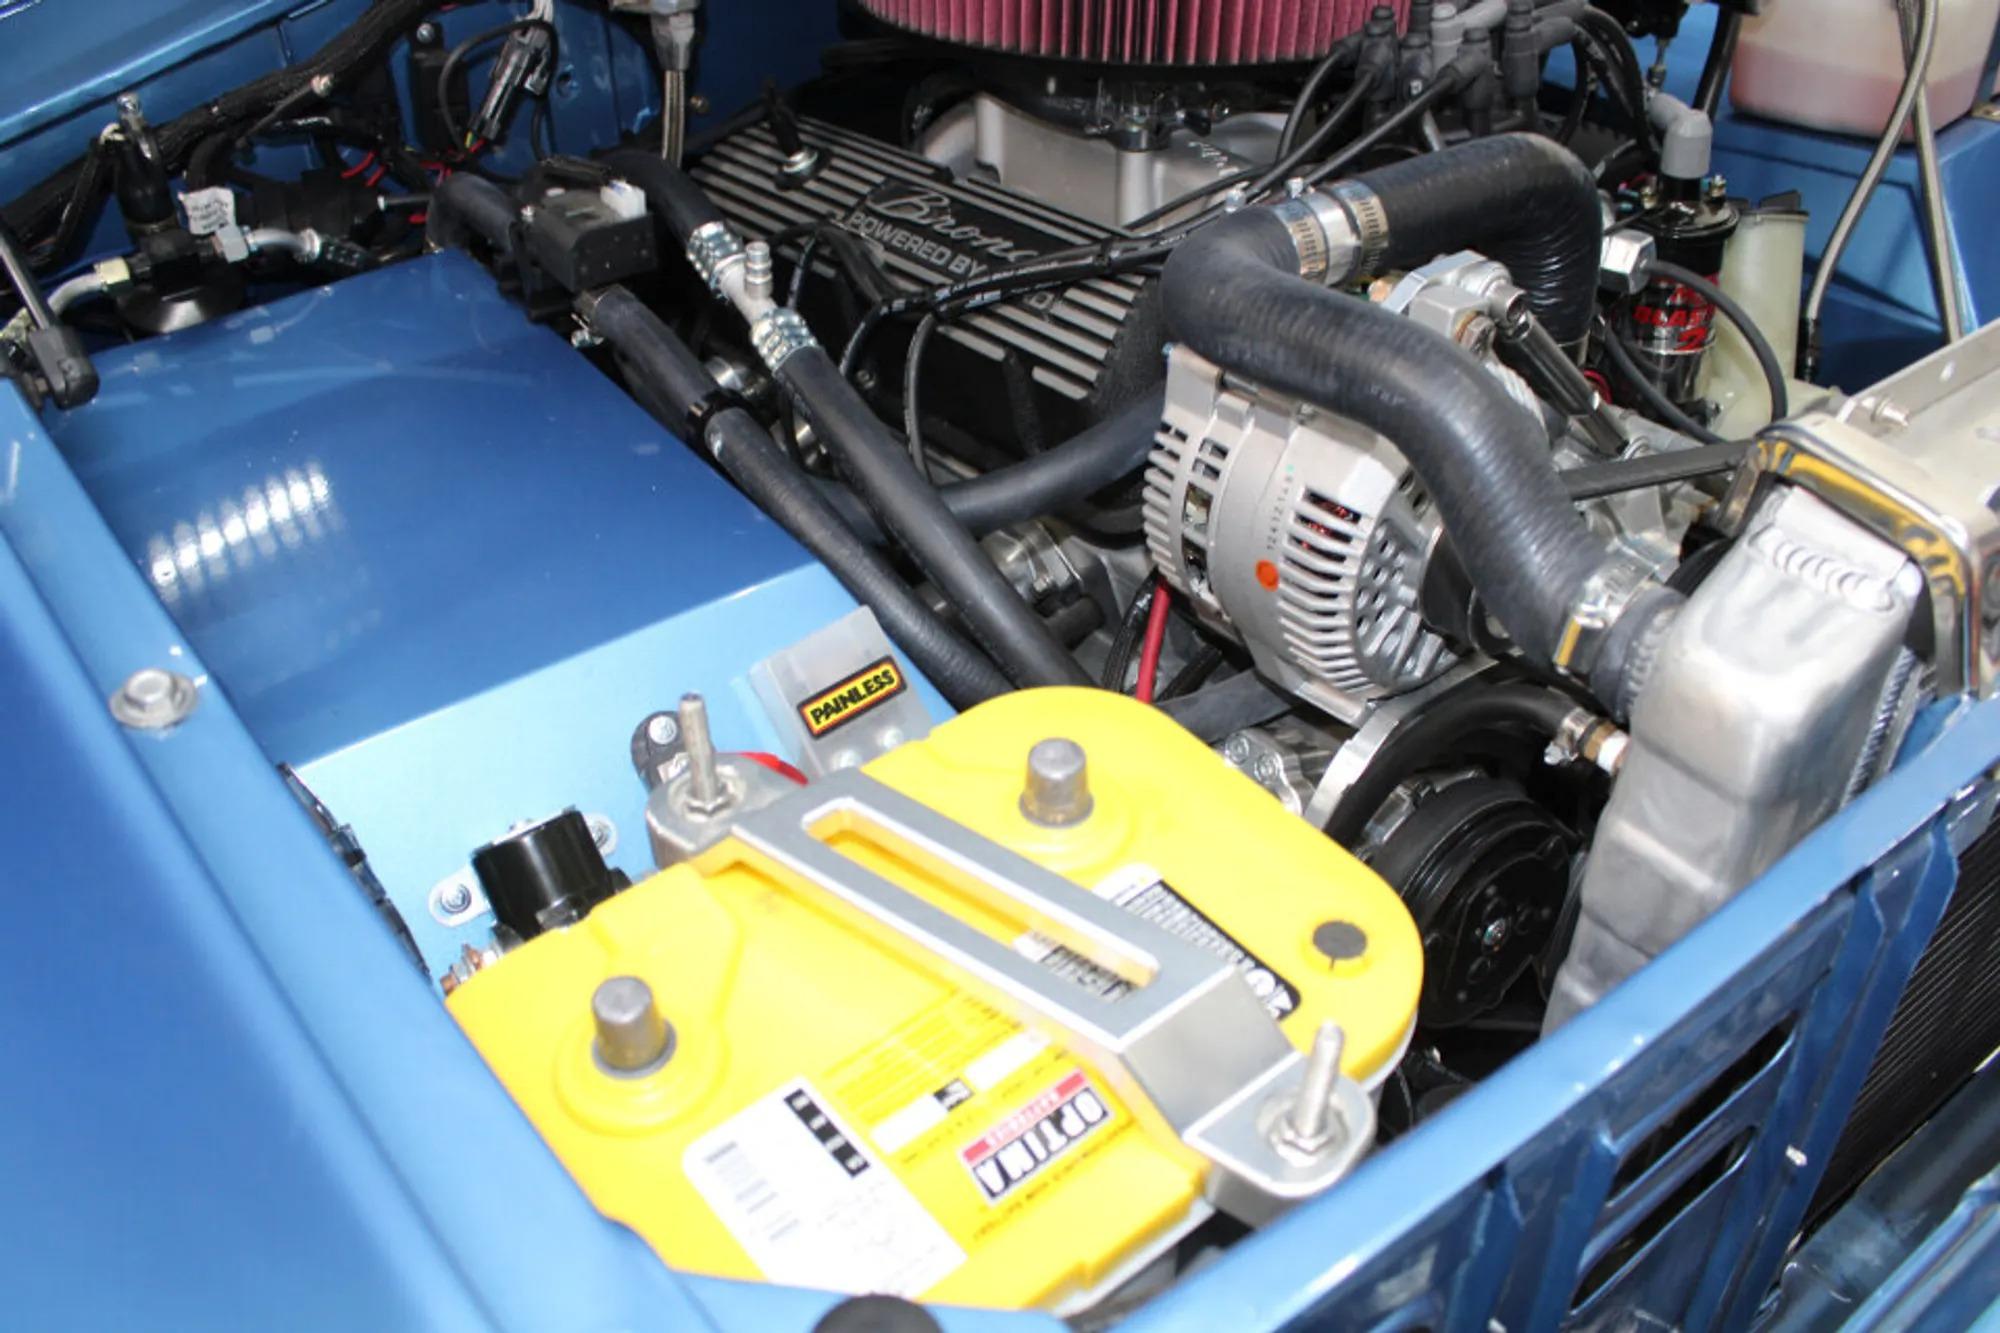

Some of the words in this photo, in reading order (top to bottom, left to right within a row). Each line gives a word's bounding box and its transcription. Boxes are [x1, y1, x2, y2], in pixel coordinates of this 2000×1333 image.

[848, 210, 951, 267] POWERED
[949, 253, 988, 279] BY
[866, 187, 1039, 264] Bronc
[810, 669, 895, 726] PAINLESS
[973, 1088, 1107, 1197] OPTIMA
